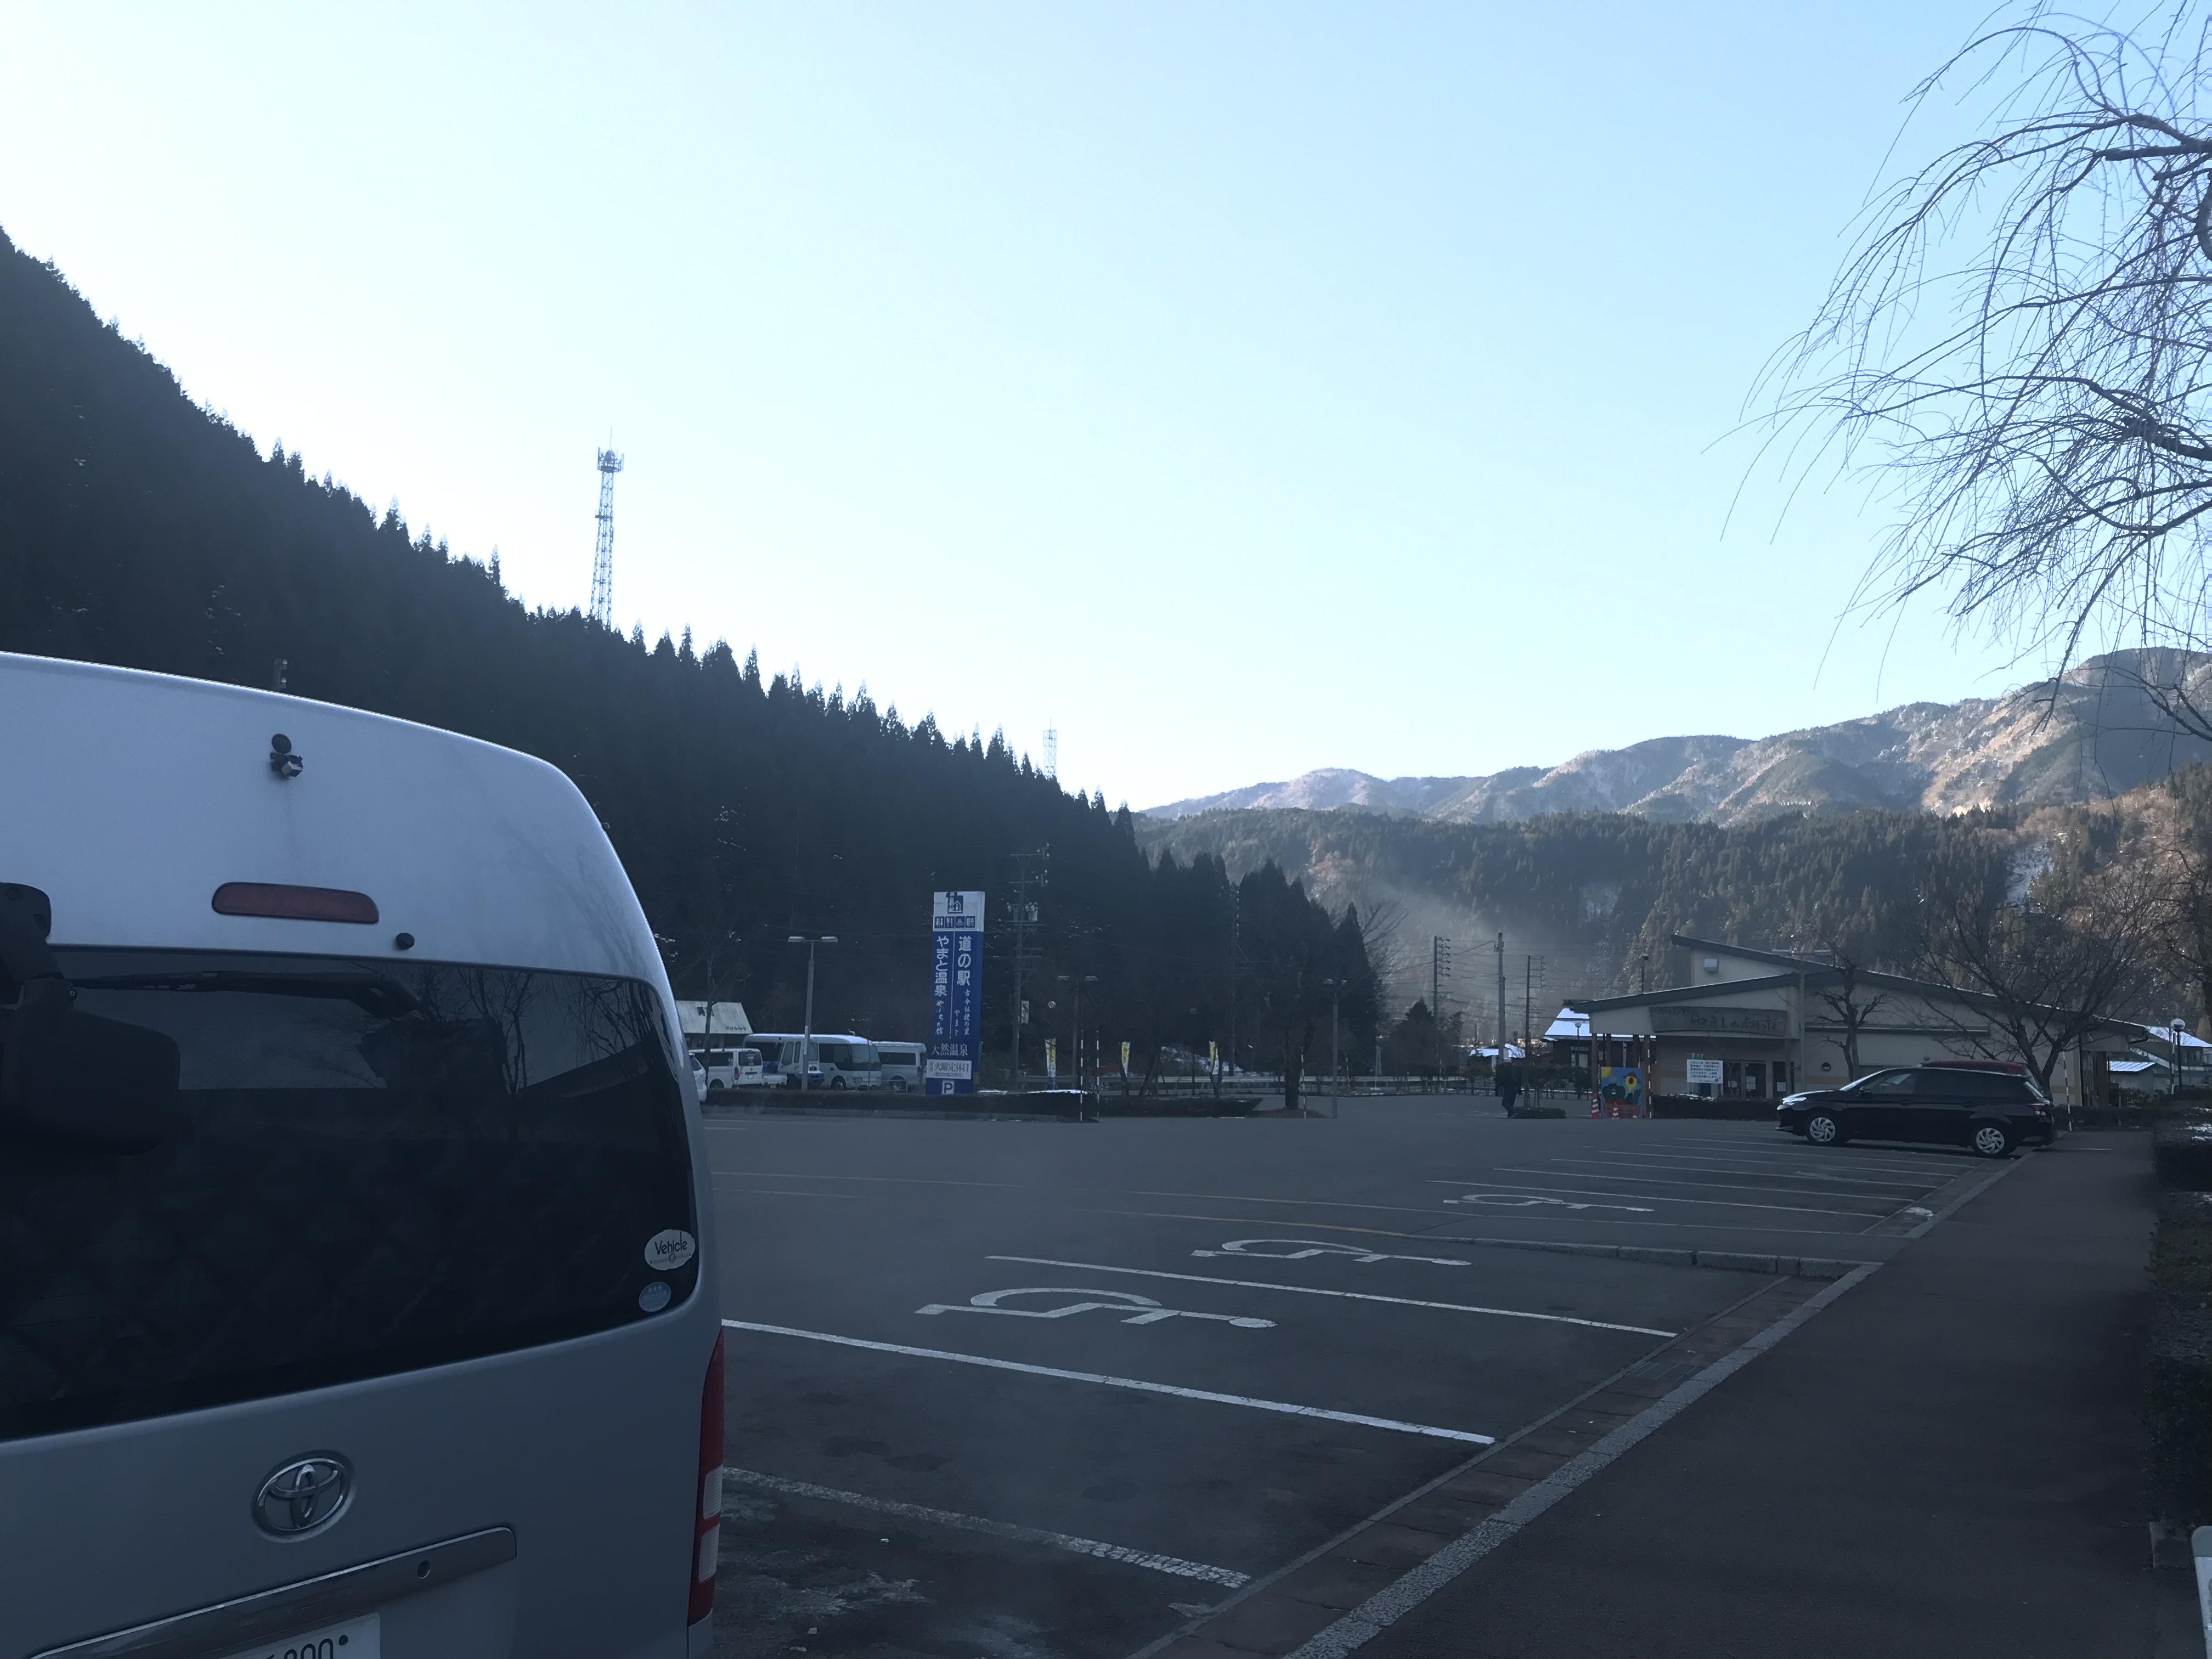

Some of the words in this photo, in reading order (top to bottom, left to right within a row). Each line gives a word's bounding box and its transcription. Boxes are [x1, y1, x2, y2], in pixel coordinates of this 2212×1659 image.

[935, 935, 950, 996] やまと温泉
[957, 935, 972, 986] 道の駅
[931, 1043, 968, 1057] 天然温泉
[944, 1082, 953, 1094] P
[654, 1231, 687, 1255] Vehicle
